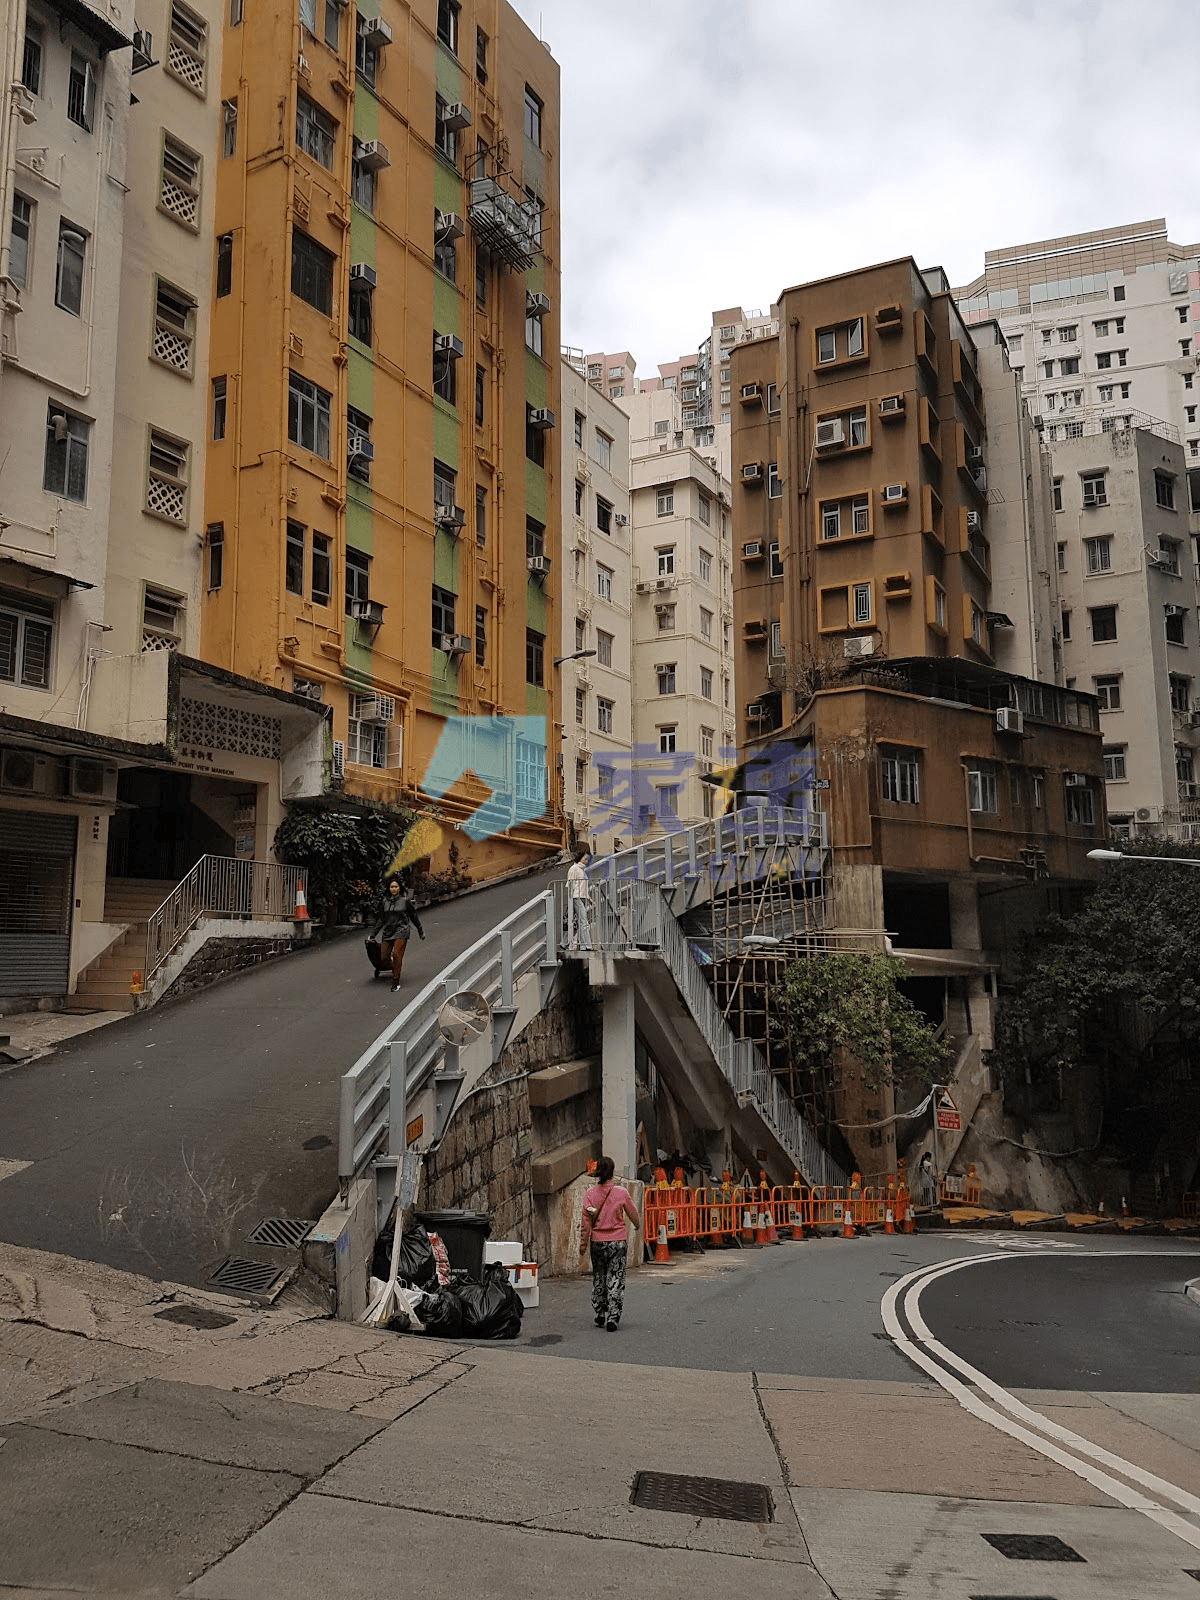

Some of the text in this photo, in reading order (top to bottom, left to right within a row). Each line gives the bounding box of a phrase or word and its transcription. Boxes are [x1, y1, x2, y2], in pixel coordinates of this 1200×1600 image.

[178, 761, 195, 769] POINT
[196, 764, 209, 772] VIEW
[211, 766, 235, 776] MANSION
